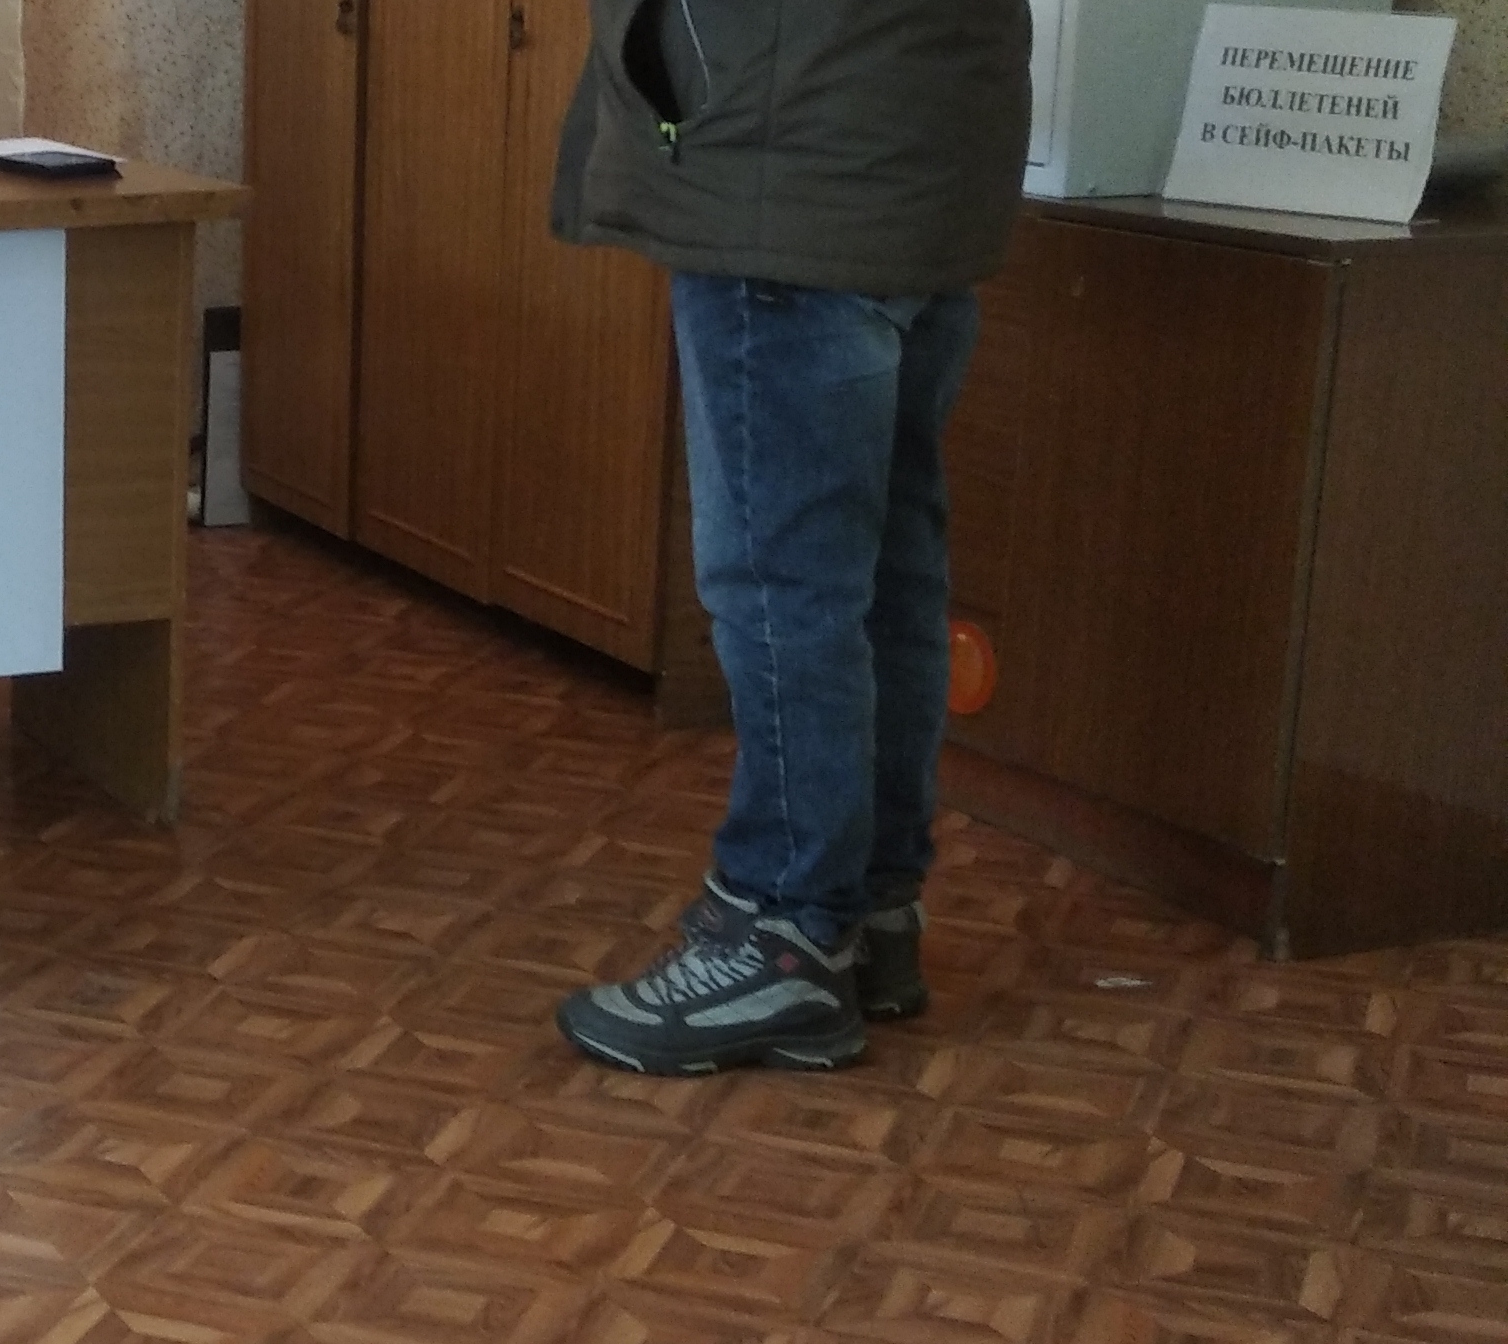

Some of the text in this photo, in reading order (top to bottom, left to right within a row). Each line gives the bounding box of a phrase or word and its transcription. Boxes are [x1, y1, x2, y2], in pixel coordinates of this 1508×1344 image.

[1220, 46, 1418, 81] ПЕРЕМЕЩЕНИЕ
[1222, 85, 1400, 120] БЮЛЛЕТЕНЕЙ
[1200, 122, 1410, 162] В СЕЙФ-ПАКЕТЫ
